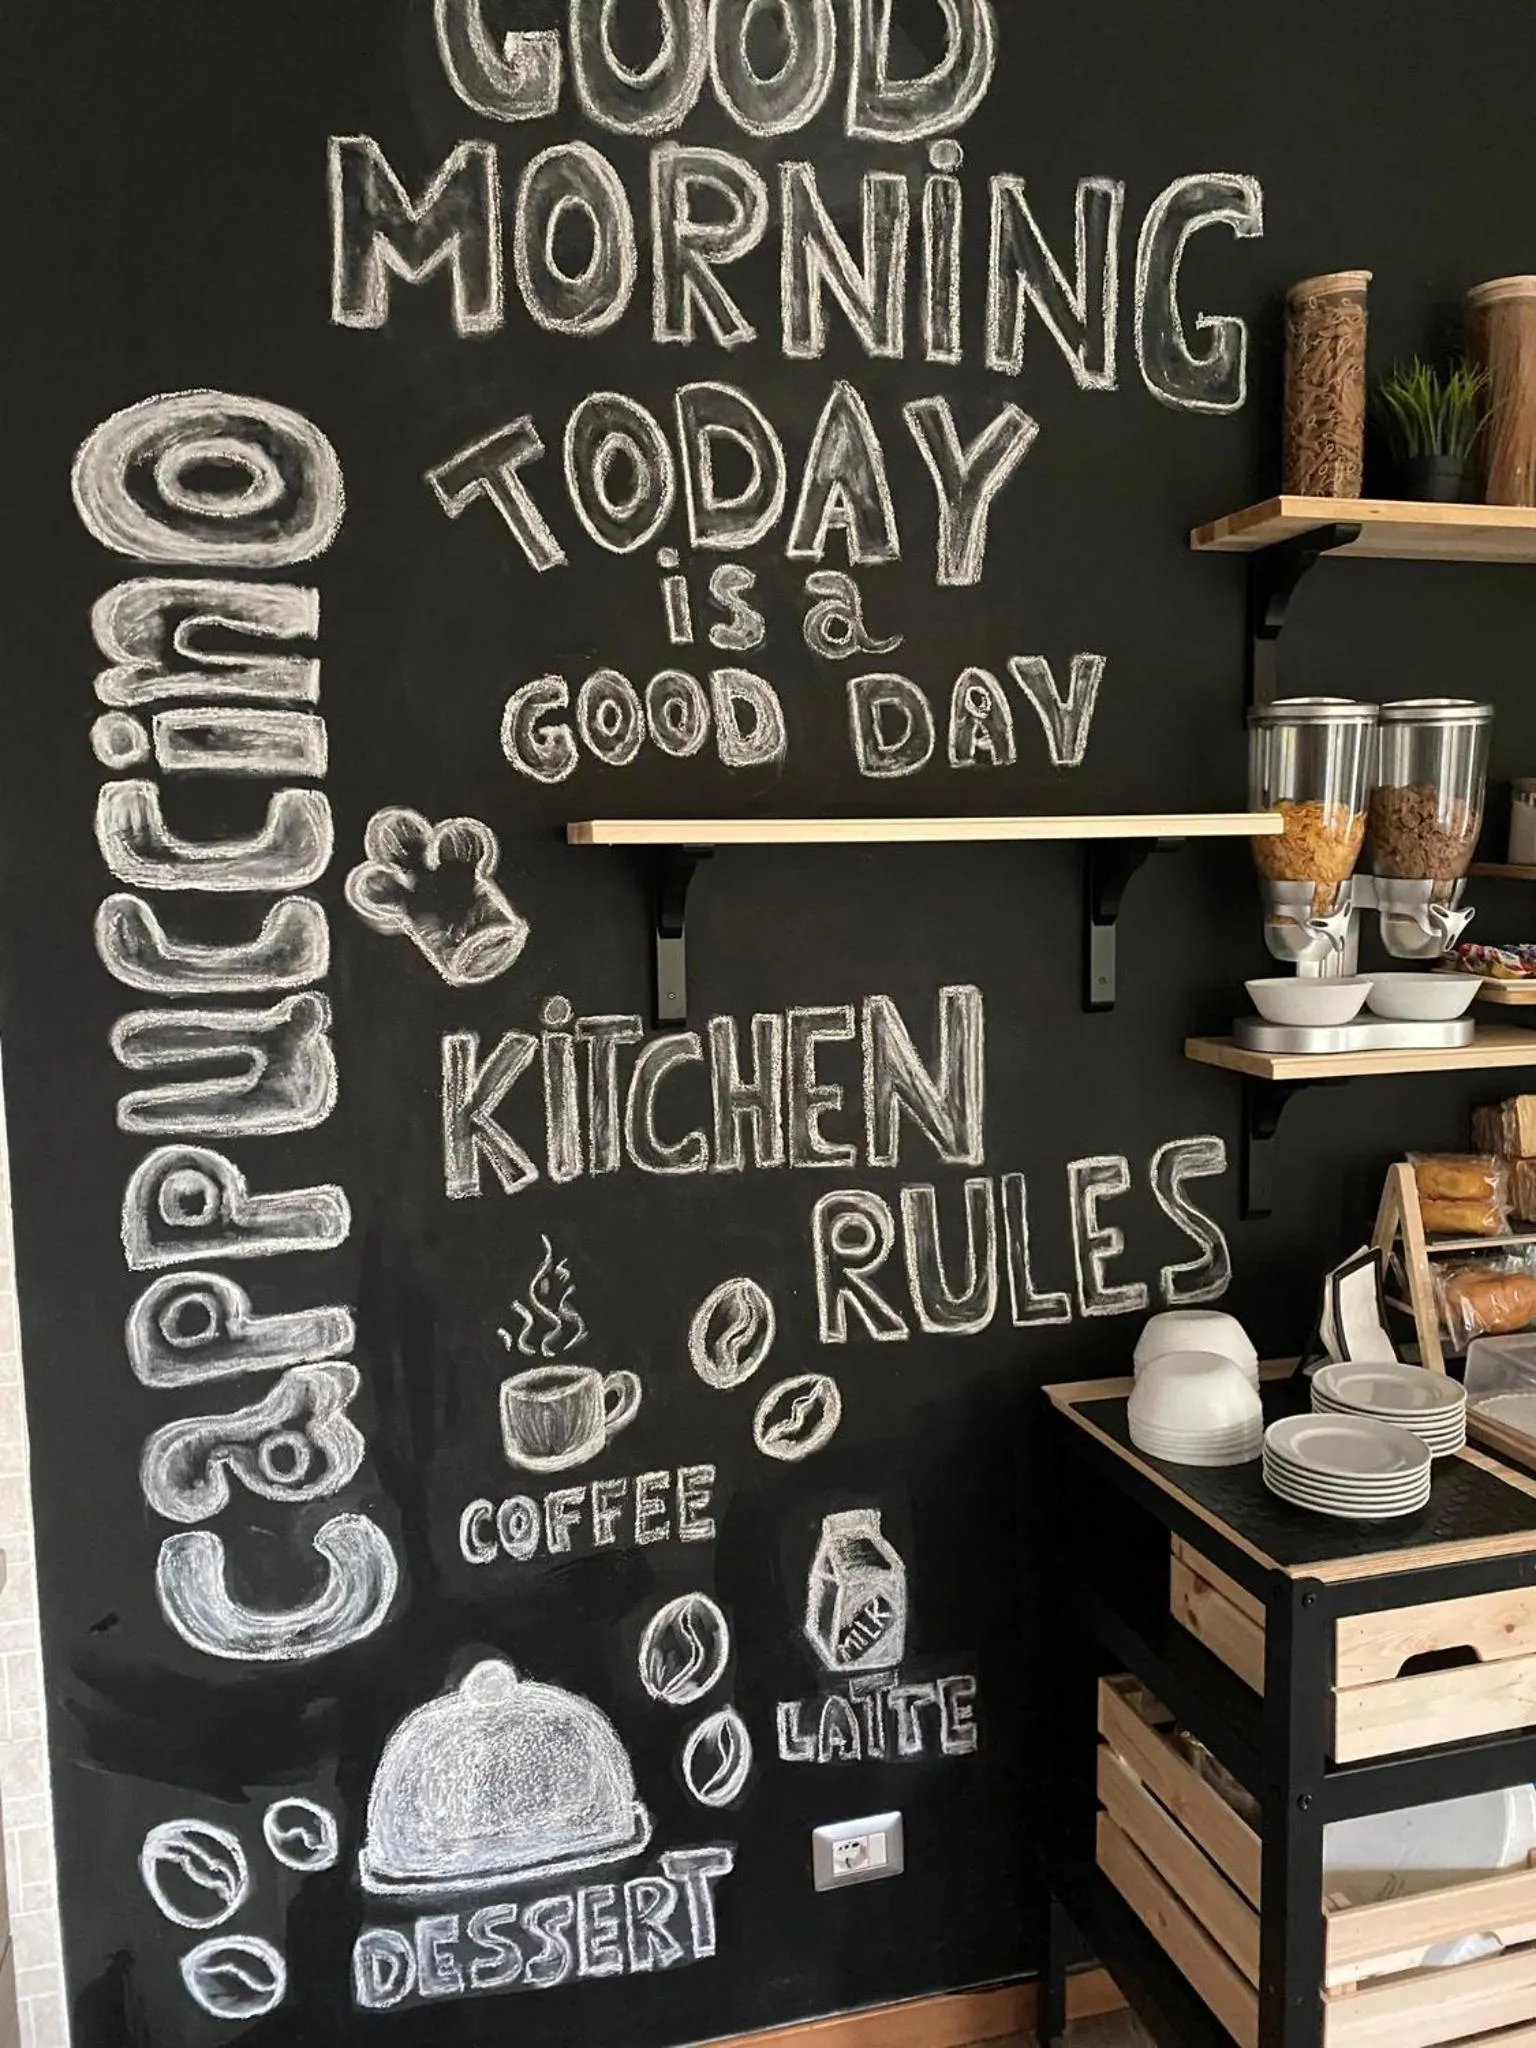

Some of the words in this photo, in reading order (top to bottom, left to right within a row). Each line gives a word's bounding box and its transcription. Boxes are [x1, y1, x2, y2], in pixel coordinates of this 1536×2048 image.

[434, 0, 997, 141] GOOD
[424, 381, 1040, 586] TODAY
[656, 545, 767, 652] is
[802, 570, 903, 660] a
[500, 667, 786, 784] GOOD
[847, 653, 1107, 777] DAY
[812, 1134, 1232, 1344] RULES
[459, 1464, 717, 1564] COFFEE
[837, 1598, 893, 1662] MILK
[776, 1675, 978, 1764] LATTE
[353, 1847, 736, 2010] DESSERT
